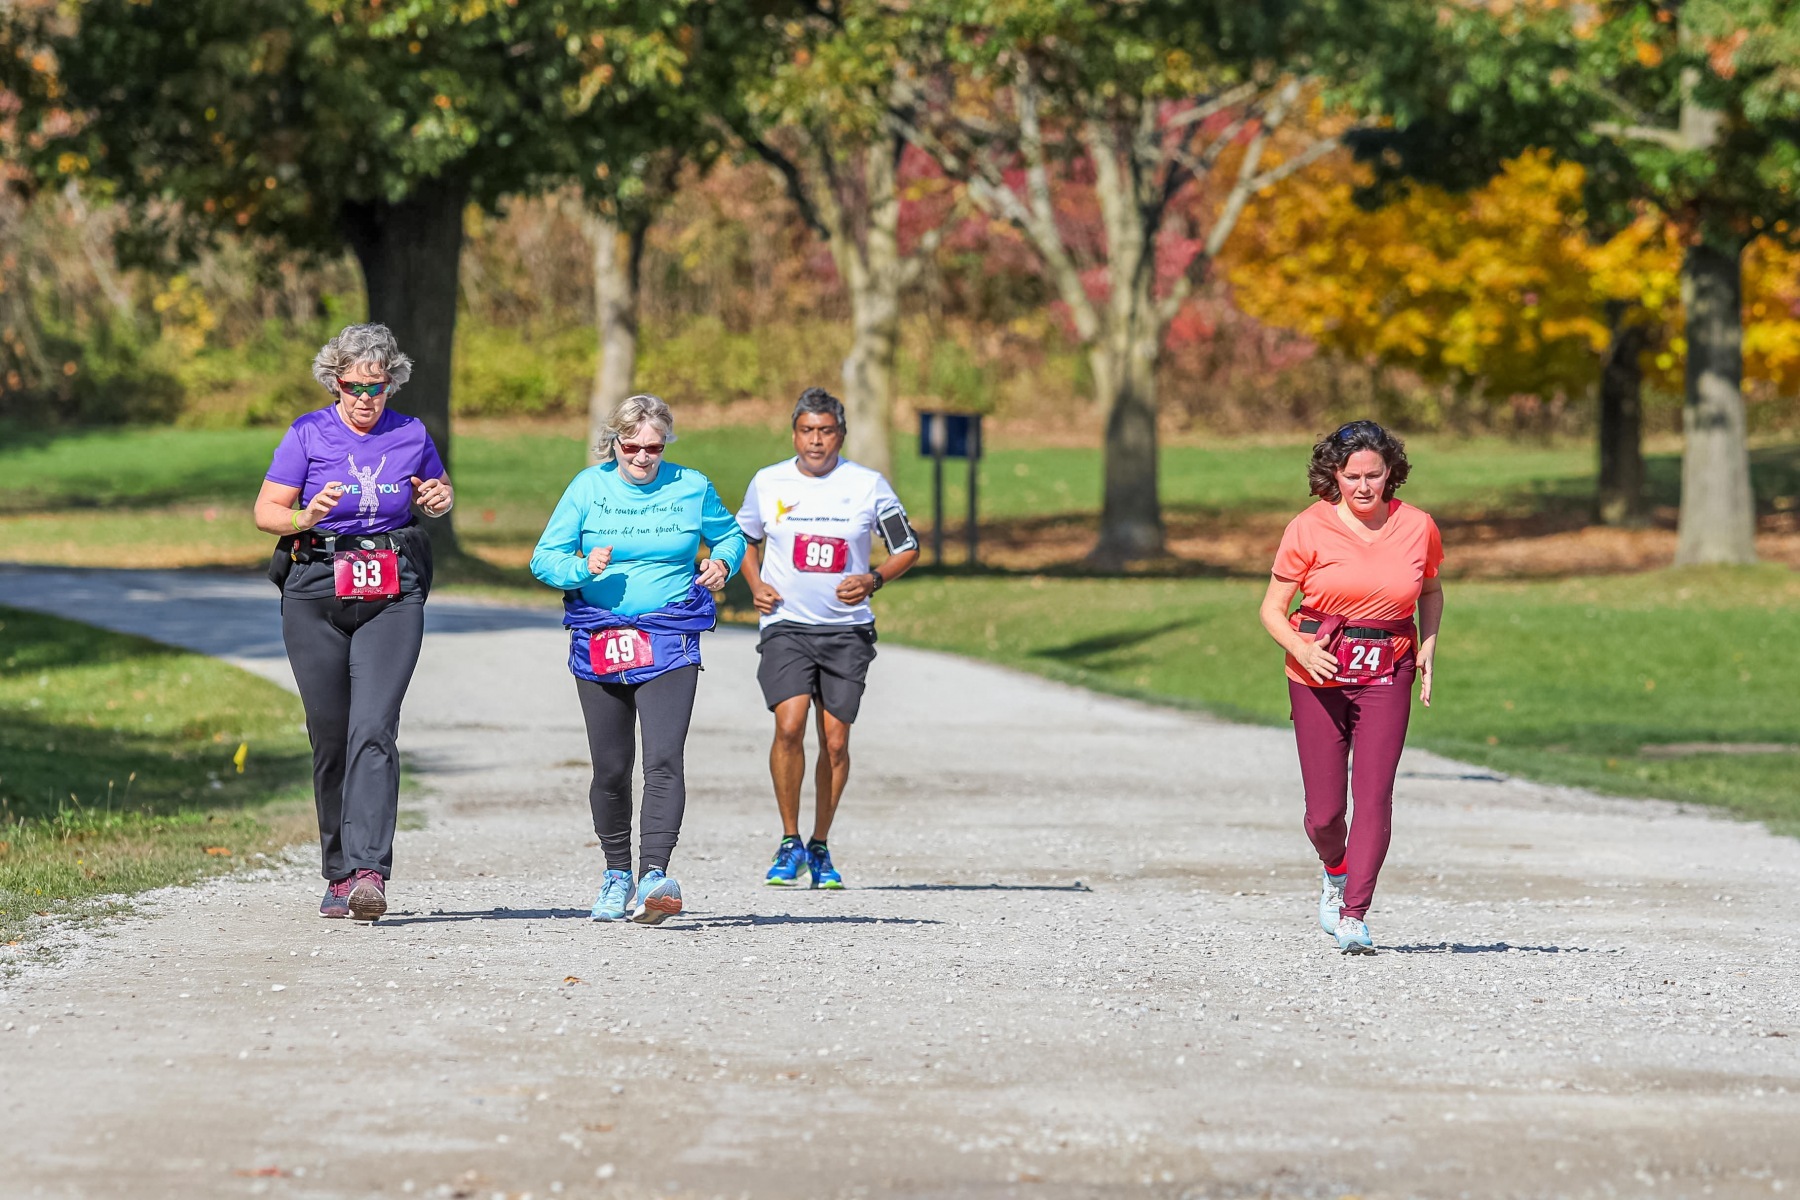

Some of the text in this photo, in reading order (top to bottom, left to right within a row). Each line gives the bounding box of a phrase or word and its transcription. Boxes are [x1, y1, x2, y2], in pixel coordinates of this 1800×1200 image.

[594, 497, 612, 518] The
[640, 504, 650, 516] of
[651, 503, 667, 514] true
[621, 526, 635, 538] did
[637, 527, 650, 535] run
[655, 523, 682, 537] smooth
[805, 541, 834, 568] 99
[352, 559, 381, 587] 93
[605, 635, 635, 664] 49
[1349, 645, 1381, 671] 24
